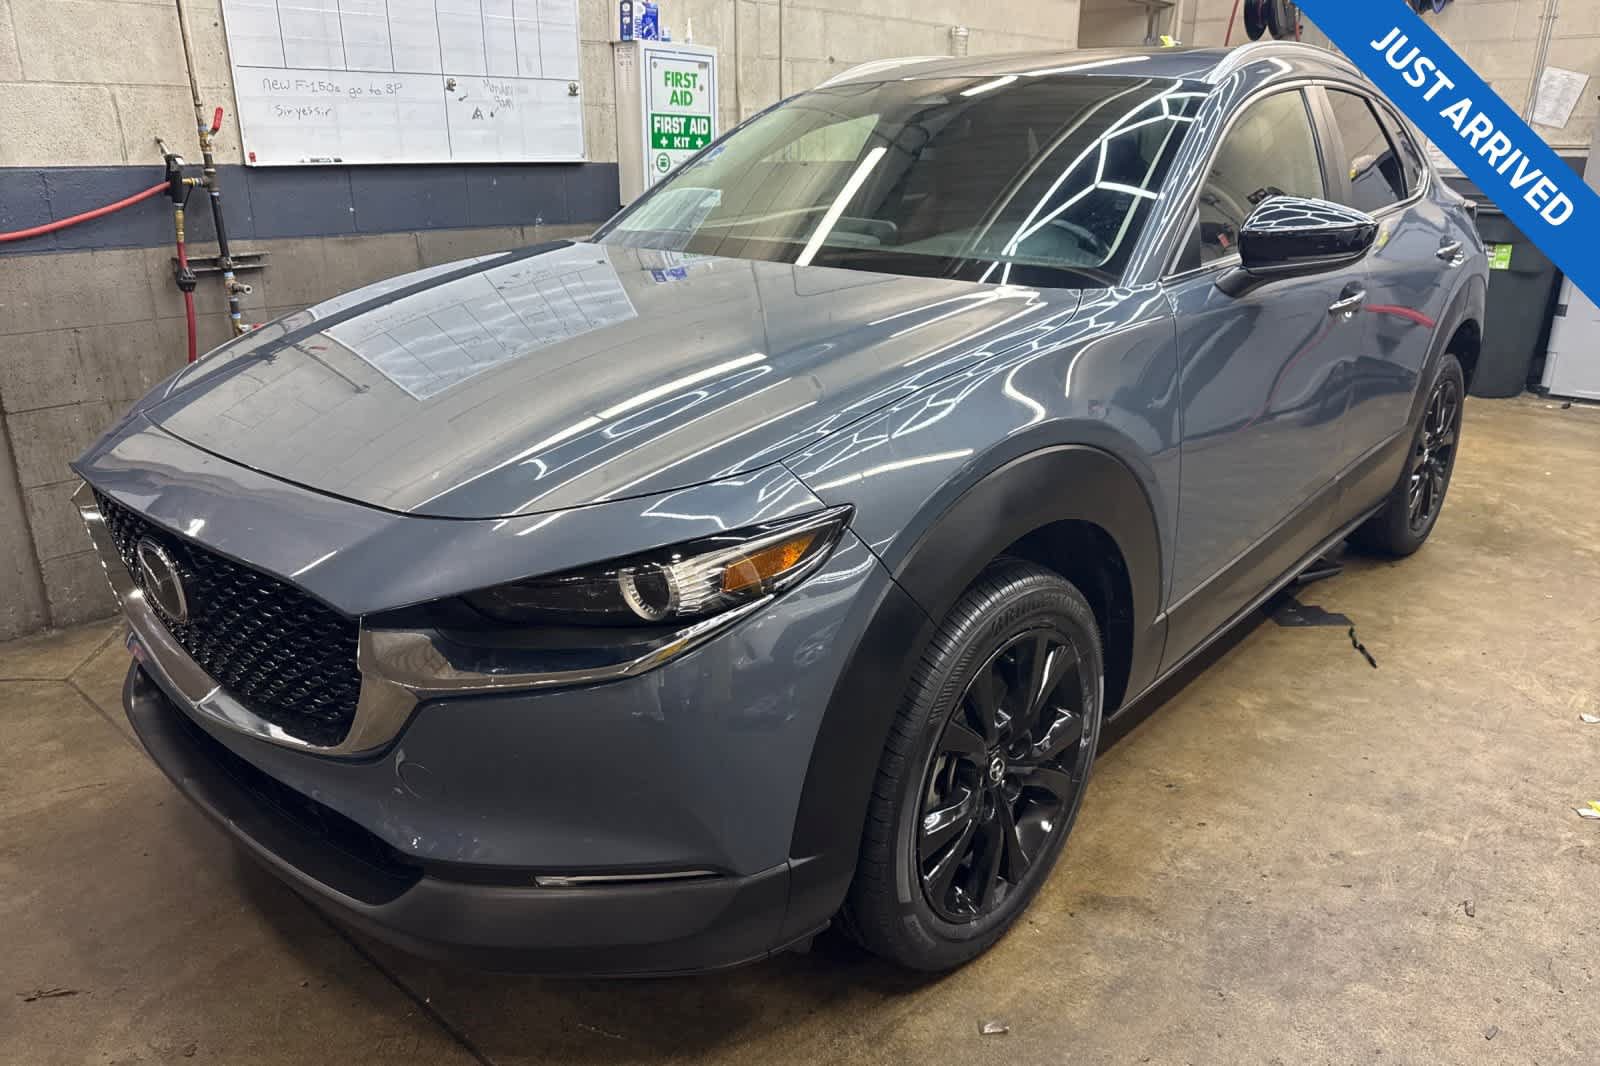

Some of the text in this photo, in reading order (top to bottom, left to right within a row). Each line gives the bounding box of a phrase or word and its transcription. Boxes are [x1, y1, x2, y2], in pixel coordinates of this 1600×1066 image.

[664, 71, 698, 89] FIRST
[349, 87, 363, 99] go
[369, 82, 383, 96] to
[669, 91, 693, 106] AID
[653, 116, 709, 135] FIRST AID
[673, 136, 691, 148] KIT
